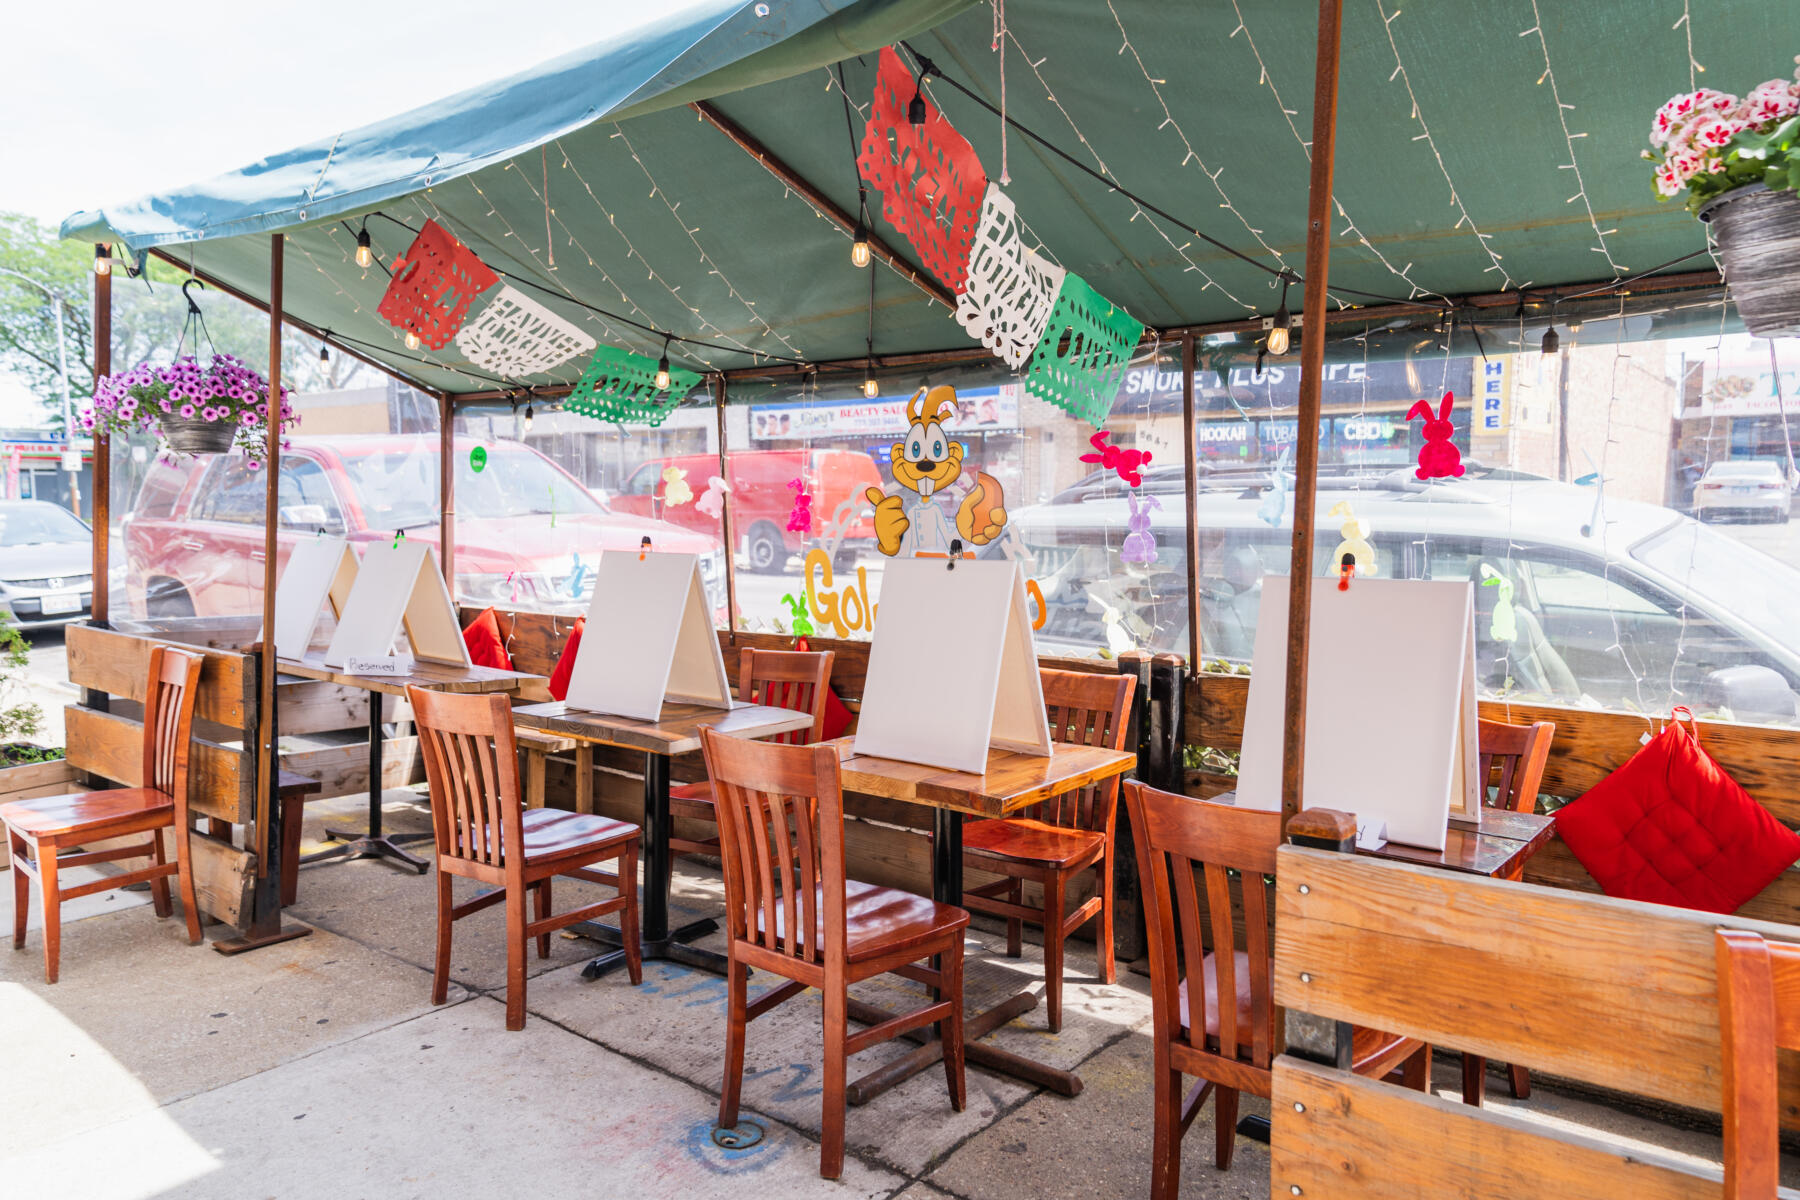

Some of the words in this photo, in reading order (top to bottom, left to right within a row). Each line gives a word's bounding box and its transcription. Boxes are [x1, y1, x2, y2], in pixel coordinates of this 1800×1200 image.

[1299, 363, 1366, 381] PE
[1485, 362, 1501, 428] HERE
[840, 406, 879, 418] BEAUTY
[883, 403, 910, 415] SAL
[1200, 426, 1246, 441] HOOKAH
[1264, 424, 1325, 441] TOBA
[1344, 421, 1381, 441] CBD
[805, 548, 878, 638] Gol
